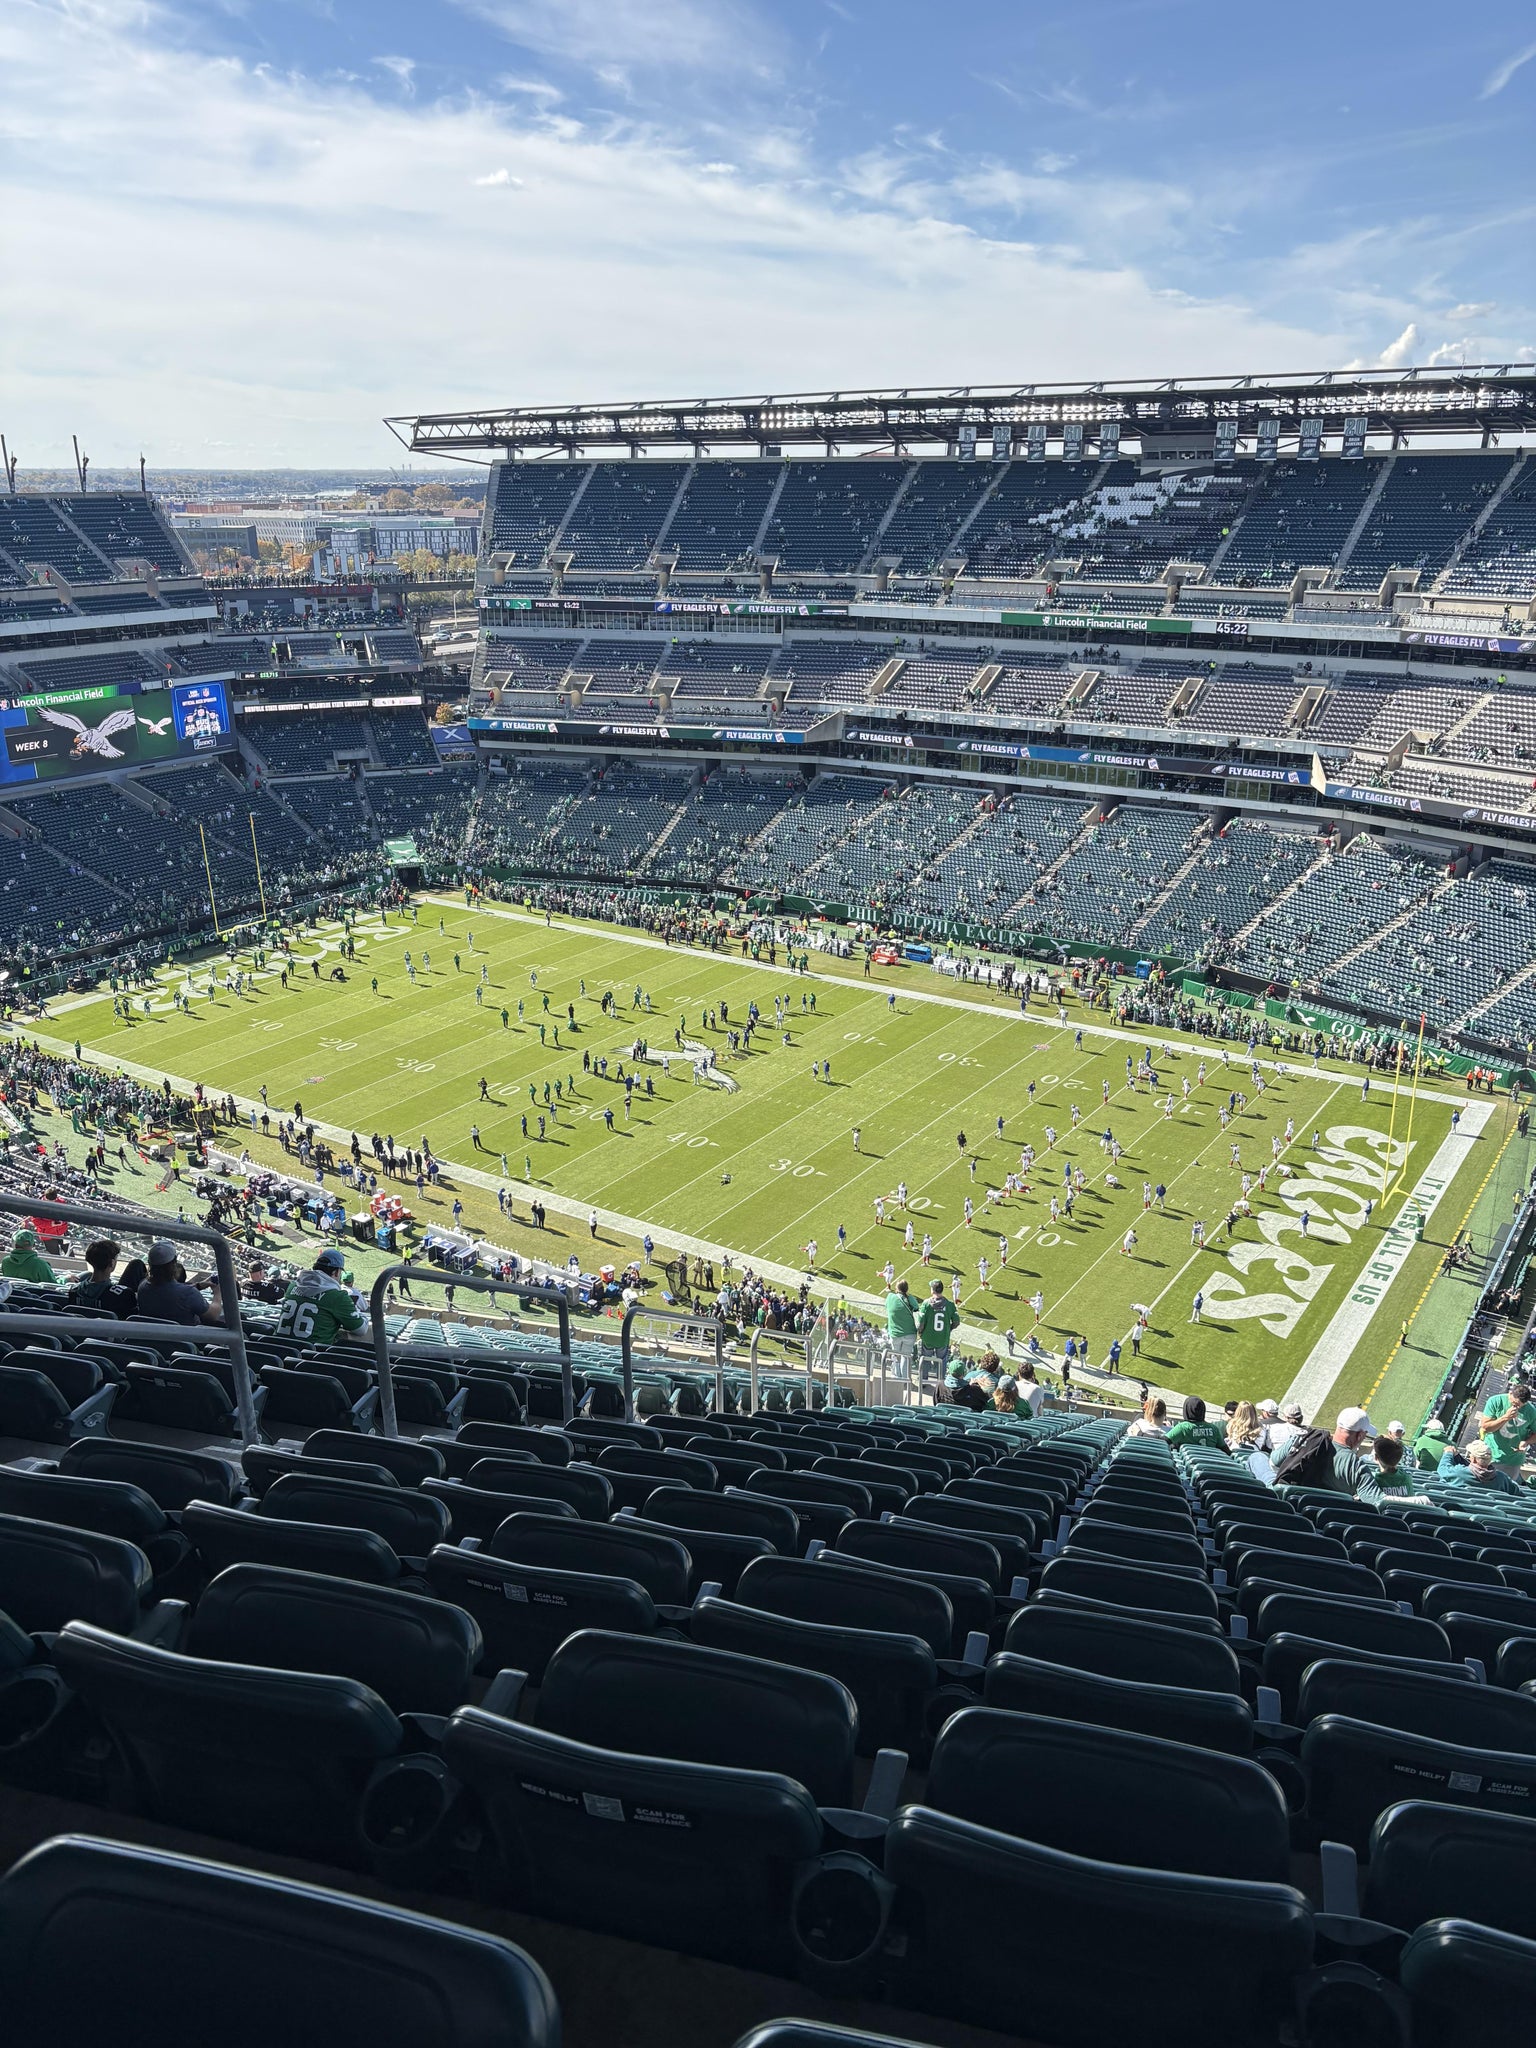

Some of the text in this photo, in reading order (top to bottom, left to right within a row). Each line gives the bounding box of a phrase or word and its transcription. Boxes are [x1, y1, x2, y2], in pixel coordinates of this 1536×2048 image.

[1029, 426, 1045, 442] 44
[1102, 425, 1119, 441] 70
[1218, 423, 1236, 439] 15
[1259, 421, 1278, 438] 40
[1302, 420, 1321, 437] 99
[1346, 418, 1365, 437] 20
[964, 428, 972, 442] 5
[188, 518, 202, 528] FS
[671, 603, 718, 612] FLY EAGLES FLY
[760, 605, 785, 613] EAGLES
[1054, 617, 1148, 630] Lincoln Financial Field
[1216, 623, 1248, 635] 45:22
[1424, 634, 1438, 644] FLY
[1439, 635, 1469, 646] EAGLES
[1469, 637, 1485, 648] FLY
[12, 688, 104, 708] Lincoln Financial Field
[502, 721, 546, 731] FLY EAGLES FLY
[612, 726, 624, 734] FLY
[624, 727, 646, 736] EAGLES
[726, 731, 773, 741] FLY EAGLES FLY
[859, 732, 902, 744] FLY EAGLES FLY
[15, 739, 49, 752] WEEK 8
[971, 743, 1019, 755] FLY EAGLES FLY
[1093, 754, 1146, 767] FLY EAGLES FLY
[1229, 766, 1286, 780] FLY EAGLES FLY
[1351, 789, 1408, 807] FLY EAGLES FLY
[1482, 811, 1497, 822] FLY
[1497, 813, 1529, 828] EAGLES
[847, 905, 1027, 947] PHILDELPHIA EAGLES
[1331, 1020, 1355, 1038] GO
[318, 1037, 358, 1052] 20
[396, 1058, 436, 1074] 30
[666, 1131, 710, 1148] 40
[769, 1158, 816, 1177] 30
[1009, 1225, 1061, 1247] 10
[1201, 1125, 1418, 1340] EAGLES
[1351, 1176, 1446, 1306] IT TAKES ALL OF US
[277, 1299, 319, 1339] 26
[933, 1312, 945, 1332] 6
[1192, 1427, 1214, 1438] HURTS
[467, 1578, 483, 1588] NEED
[533, 1596, 568, 1607] ASSISTANCE
[534, 1592, 551, 1600] SCAN
[1394, 1764, 1417, 1775] NEED
[521, 1781, 546, 1796] NEED
[1487, 1787, 1530, 1797] ASSISTANCE
[1491, 1782, 1512, 1790] SCAN
[635, 1807, 686, 1821] SCAN FOR
[633, 1814, 692, 1829] ASSISTANCE
